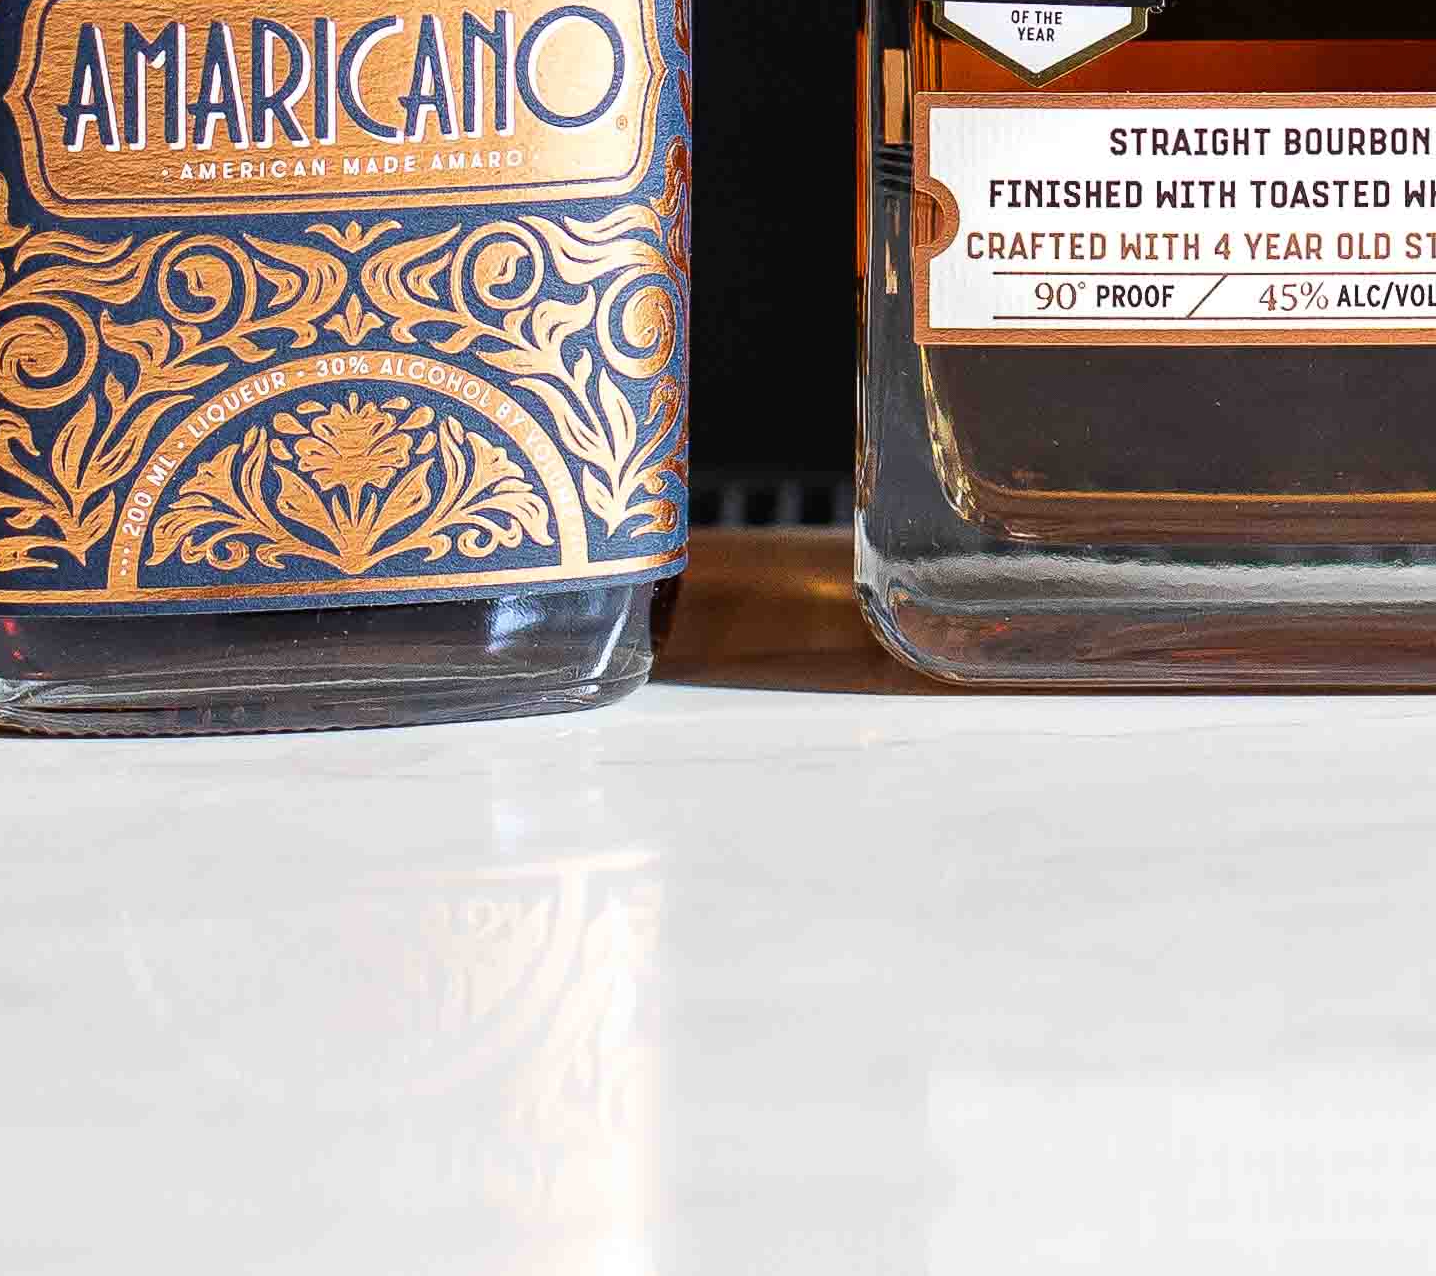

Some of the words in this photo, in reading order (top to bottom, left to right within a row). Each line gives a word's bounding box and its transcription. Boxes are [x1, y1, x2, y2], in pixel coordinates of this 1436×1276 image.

[1011, 10, 1031, 24] OF
[1035, 11, 1062, 25] THE
[1018, 27, 1055, 42] YEAR
[57, 5, 625, 153] AMARICANO
[1109, 127, 1270, 156] STRAIGHT
[1284, 127, 1430, 155] BOURBON
[179, 158, 326, 180] AMERICAN
[343, 155, 418, 175] MADE
[430, 150, 524, 170] AMARO
[989, 180, 1143, 210] FINISHED
[1156, 180, 1236, 209] WITH
[1250, 180, 1390, 208] TOASTED
[966, 231, 1107, 261] CRAFTED
[1120, 232, 1200, 261] WITH
[1213, 232, 1231, 261] 4
[1244, 232, 1322, 260] YEAR
[1337, 232, 1391, 260] OLD
[1095, 283, 1175, 309] PROOF
[1258, 281, 1330, 313] 45%
[123, 491, 152, 537] 200
[147, 453, 178, 487] ML
[186, 371, 287, 439] LIQUEUR
[316, 355, 370, 377] 30%
[379, 358, 490, 408] ALCOHOL
[496, 401, 526, 427] BY
